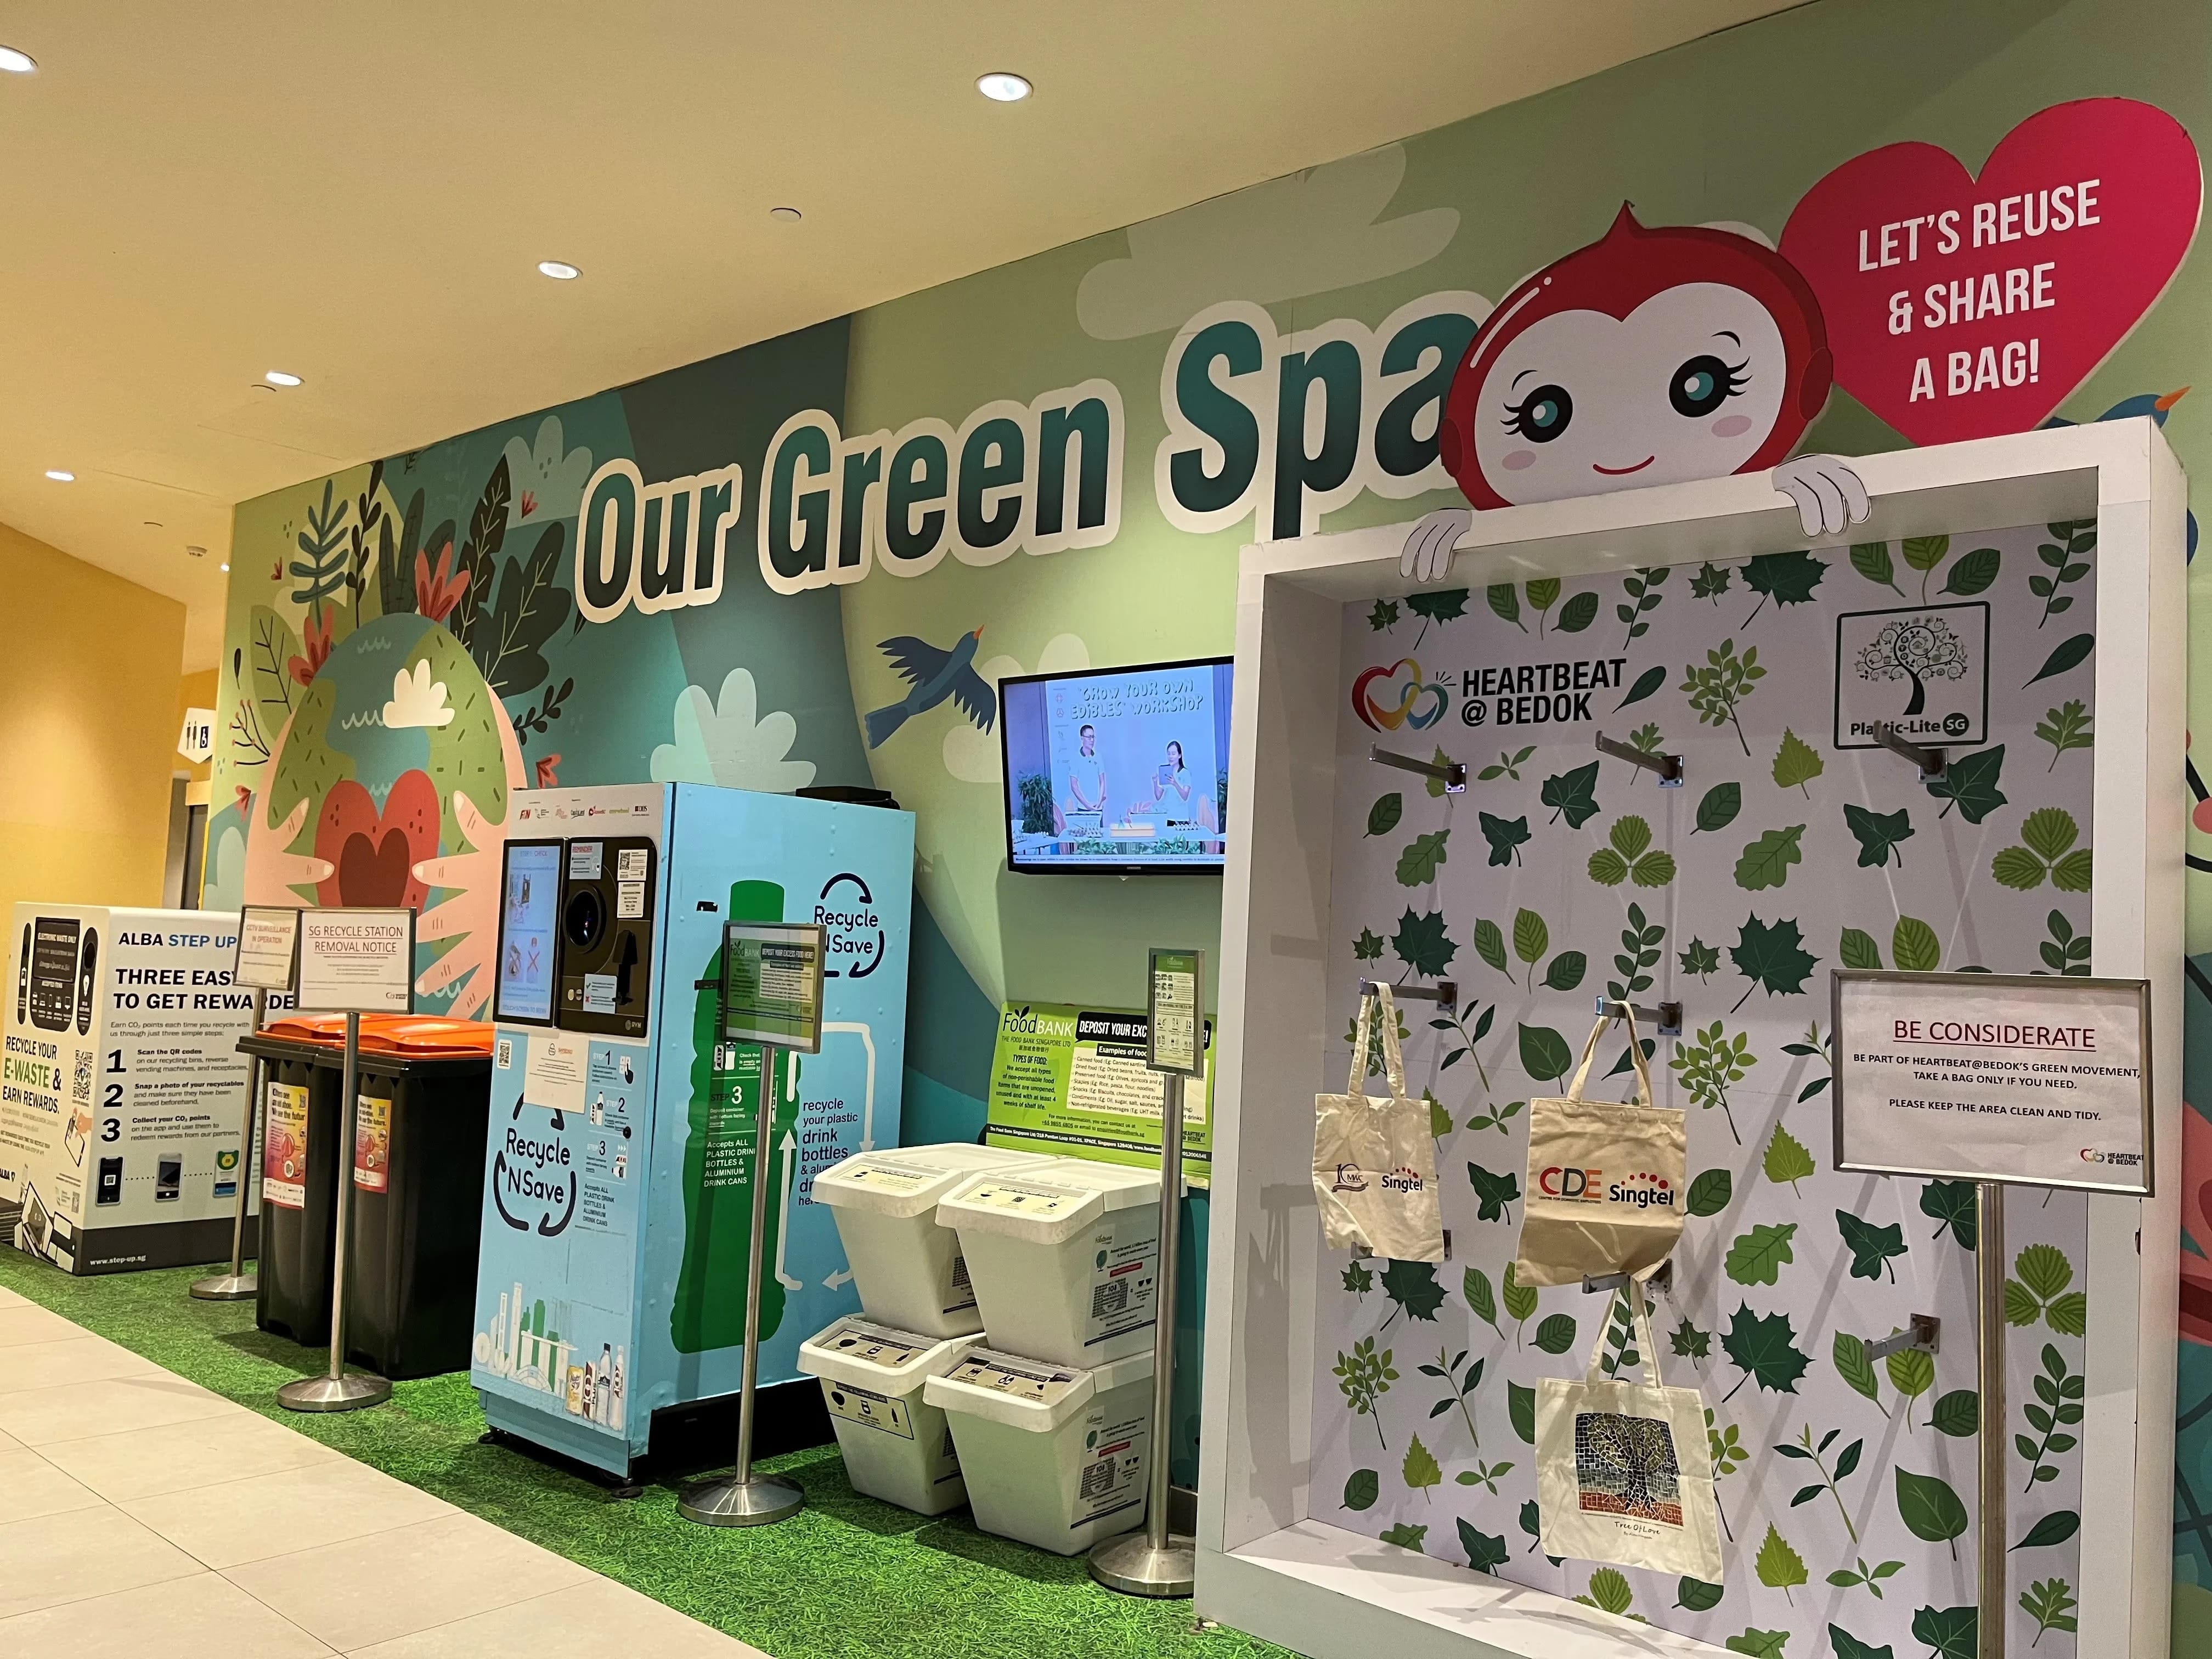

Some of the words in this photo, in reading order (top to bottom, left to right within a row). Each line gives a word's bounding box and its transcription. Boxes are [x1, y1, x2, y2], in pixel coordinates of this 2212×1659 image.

[1859, 210, 1960, 272] LET'S
[1973, 179, 2100, 248] REUSE
[1889, 291, 1912, 335] &
[1925, 262, 2055, 328] SHARE
[1909, 357, 1935, 403] A
[1948, 338, 2039, 396] BAG!
[583, 472, 732, 609] Our
[769, 398, 1109, 579] Green
[1170, 313, 1480, 539] Spa
[1463, 658, 1627, 697] HEARTBEAT
[1125, 679, 1158, 698] YOUR
[1163, 679, 1194, 695] OWN
[1132, 693, 1204, 715] WORKSHOP
[1462, 699, 1487, 727] @
[1496, 692, 1593, 725] BEDOK
[1850, 720, 1940, 735] Platic-Lite
[1946, 719, 1966, 730] SG
[814, 906, 878, 932] Recycle
[119, 933, 163, 946] ALBA
[168, 934, 210, 947] STEP
[215, 936, 237, 948] UP
[308, 926, 320, 936] SG
[324, 926, 362, 936] RECYCLE
[365, 926, 403, 937] STATION
[315, 941, 360, 952] REMOVAL
[363, 943, 397, 952] NOTICE
[115, 968, 185, 985] THREE
[191, 970, 234, 986] EAS
[113, 993, 139, 1009] TO
[146, 994, 188, 1009] GET
[1003, 1013, 1074, 1037] FoodBANK
[1079, 1020, 1110, 1035] DEPOSIT
[1111, 1023, 1131, 1036] YOUR
[1131, 1024, 1148, 1038] EXC
[1894, 1020, 1922, 1039] BE
[1929, 1022, 2096, 1048] CONSIDERATE
[5, 1036, 37, 1056] RECYCLE
[38, 1041, 57, 1060] YOUR
[1098, 1046, 1126, 1056] Examples
[106, 1049, 127, 1073] 1
[605, 1050, 611, 1065] 1
[1013, 1054, 1026, 1063] TYPES
[1034, 1057, 1047, 1065] FOOD:
[1853, 1053, 1866, 1062] BE
[1868, 1054, 1893, 1064] PART
[1896, 1056, 1910, 1065] OF
[1912, 1057, 2029, 1071] HEARTBEAT@BEDOK'S
[2032, 1063, 2068, 1074] GREEN
[2071, 1065, 2140, 1080] MOVEMENT,
[4, 1057, 50, 1088] E-WASTE
[53, 1068, 61, 1092] &
[1914, 1071, 1938, 1081] TAKE
[1941, 1073, 1949, 1081] A
[1951, 1073, 1973, 1083] BAG
[1976, 1075, 2004, 1085] ONLY
[2007, 1076, 2016, 1085] IF
[2018, 1077, 2041, 1087] YOU
[2045, 1079, 2077, 1089] NEED.
[3, 1085, 22, 1104] EARN
[24, 1091, 60, 1114] REWARDS.
[103, 1084, 123, 1108] 2
[731, 1086, 742, 1104] 3
[618, 1097, 625, 1113] 2
[803, 1098, 844, 1113] recycle
[1889, 1099, 1925, 1109] PLEASE
[1928, 1101, 1953, 1110] KEEP
[1956, 1103, 1976, 1112] THE
[1979, 1104, 2007, 1114] AREA
[2010, 1107, 2044, 1117] CLEAN
[2047, 1109, 2072, 1119] AND
[2074, 1111, 2101, 1121] TIDY.
[803, 1116, 825, 1128] your
[827, 1113, 858, 1126] plastic
[100, 1118, 121, 1142] 3
[803, 1127, 838, 1144] drink
[506, 1127, 571, 1169] Recycle
[599, 1141, 606, 1156] 3
[706, 1149, 736, 1158] PLASTIC
[802, 1146, 848, 1162] bottles
[704, 1167, 744, 1177] ALUMINIUM
[706, 1159, 737, 1167] BOTTLES
[800, 1165, 808, 1175] &
[704, 1178, 726, 1187] DRINK
[1381, 1175, 1423, 1193] Singtel
[1539, 1167, 1602, 1199] CDE
[1609, 1184, 1674, 1209] Singtel
[90, 1254, 146, 1266] www.step-up.sg
[1633, 1524, 1642, 1532] Of
[1643, 1526, 1661, 1535] Love
